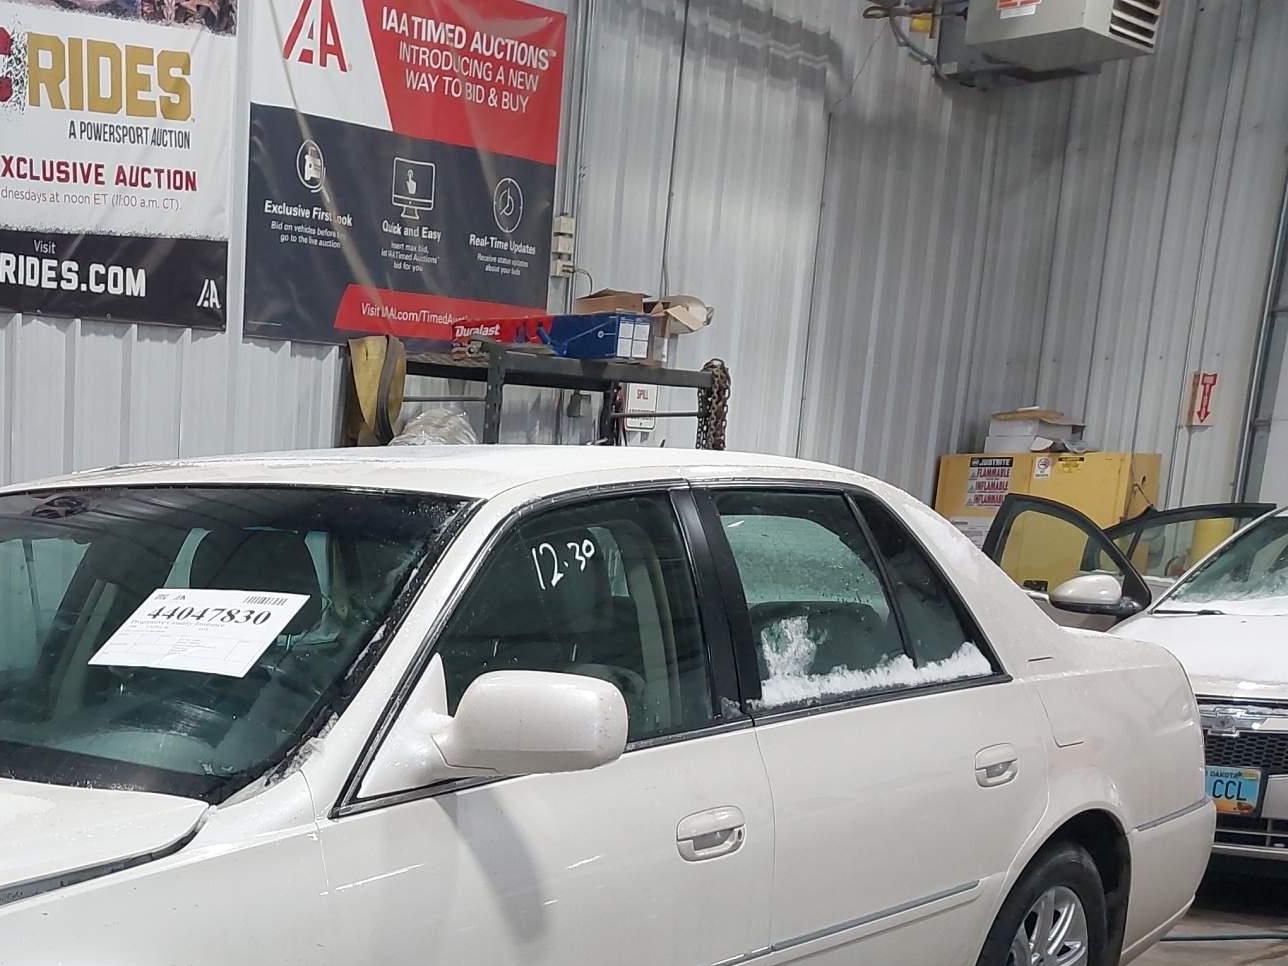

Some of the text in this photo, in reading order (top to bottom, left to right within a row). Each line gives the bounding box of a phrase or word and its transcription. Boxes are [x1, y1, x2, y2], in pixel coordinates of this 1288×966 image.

[382, 6, 409, 37] IAA
[411, 15, 464, 49] TIMED
[399, 41, 539, 92] INTRODUCING A NEW
[405, 69, 530, 113] WAY TO BID & BUY
[68, 120, 191, 150] A POWERSPORT AUCTION
[114, 164, 198, 192] AUCTION
[49, 191, 60, 203] at
[63, 193, 91, 205] noon
[93, 192, 109, 206] ET
[139, 197, 160, 209] a.m.
[264, 200, 311, 219] Exclusive
[271, 221, 283, 231] Bid
[294, 224, 316, 235] vehicles
[317, 227, 336, 238] before
[382, 220, 442, 243] Quick and Easy
[33, 240, 56, 255] Visit
[280, 234, 289, 243] go
[290, 234, 298, 242] to
[298, 235, 308, 244] the
[319, 238, 341, 249] auction
[469, 233, 536, 255] Real-Time Updates
[361, 302, 381, 317] Visit
[455, 323, 501, 338] Duralast
[146, 605, 272, 626] 44047830
[1212, 779, 1247, 802] CCL
